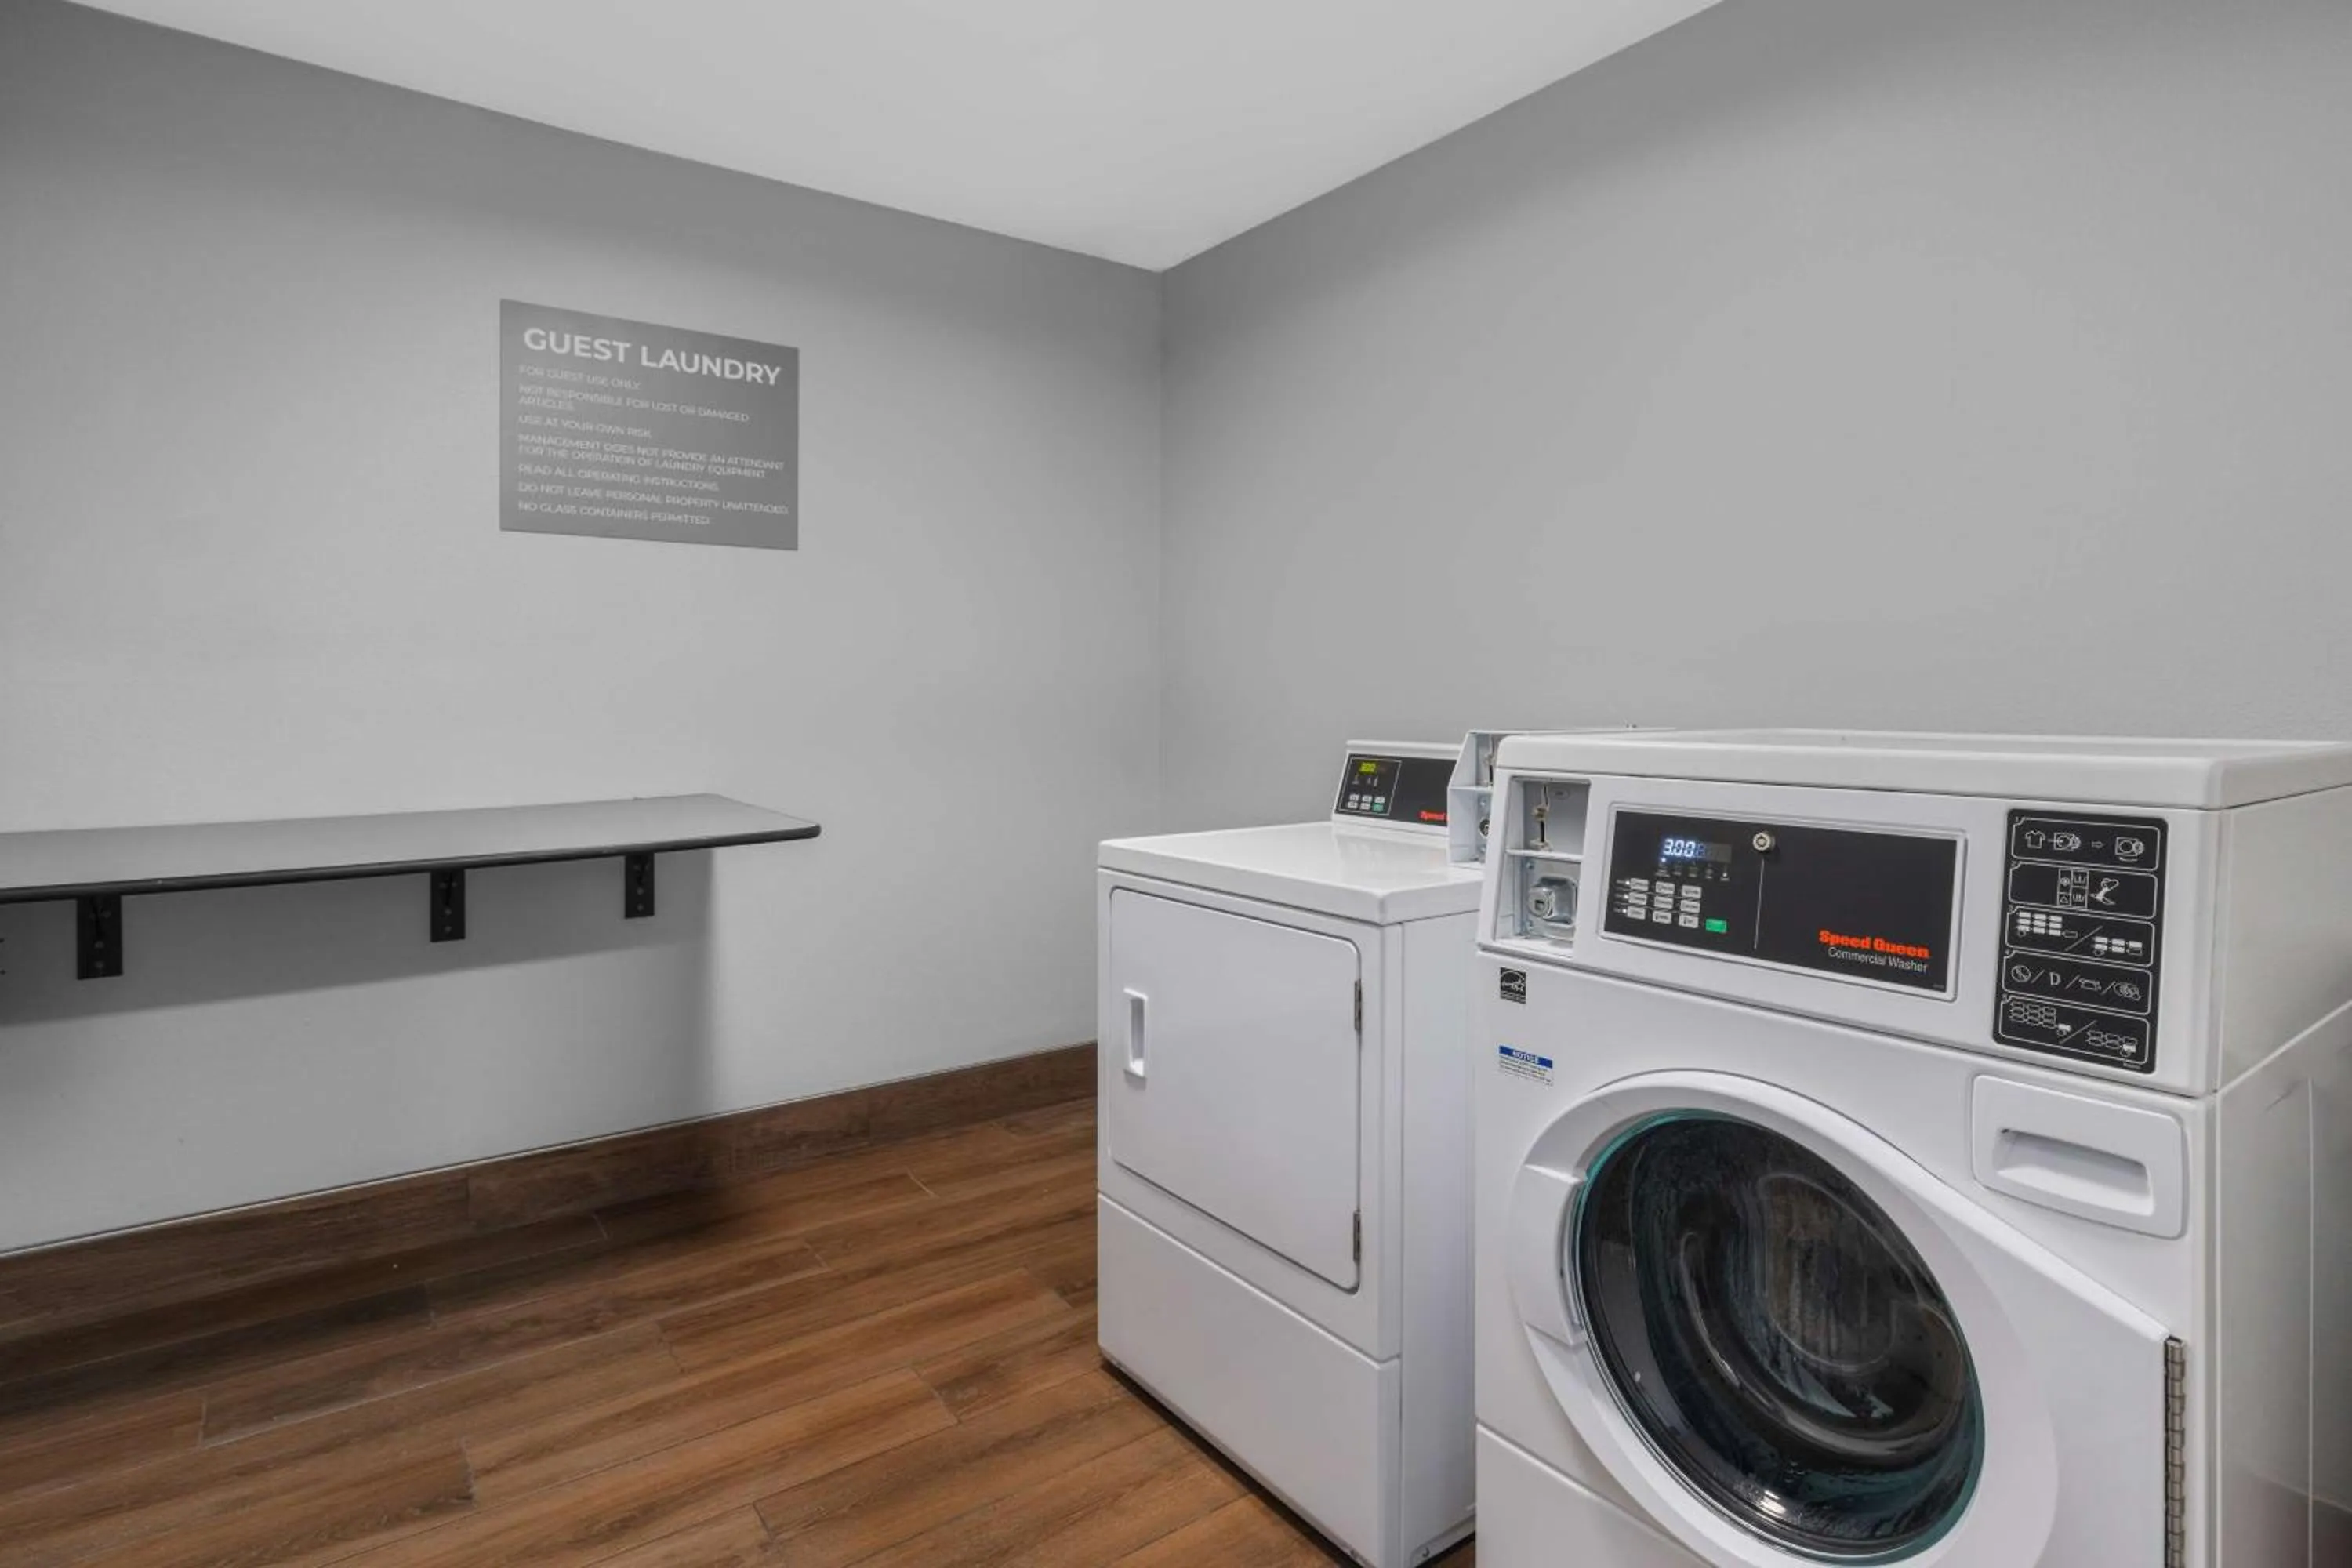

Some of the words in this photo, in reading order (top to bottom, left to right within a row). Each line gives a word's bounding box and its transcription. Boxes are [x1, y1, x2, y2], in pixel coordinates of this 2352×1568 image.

[523, 328, 631, 363] GUEST
[640, 345, 781, 386] LAUNDRY
[518, 364, 544, 376] FOR
[547, 368, 583, 381] GUEST
[587, 375, 608, 387] USE
[518, 383, 543, 394] NOT
[546, 387, 622, 405] RESPONSIBLE
[626, 397, 650, 408] FOR
[652, 401, 677, 412] LOST
[679, 405, 695, 415] OR
[698, 406, 750, 422] DAMAGED
[518, 415, 542, 426] USE
[546, 418, 558, 426] AT
[561, 419, 593, 431] YOUR
[595, 423, 625, 435] OWN
[518, 434, 600, 449] MANAGEMENT
[604, 443, 635, 454] DOES
[637, 446, 659, 457] NOT
[662, 449, 706, 462] PROVIDE
[710, 453, 725, 464] AN
[727, 457, 784, 470] ATTENDANT
[518, 445, 544, 456] FOR
[547, 448, 569, 459] THE
[572, 450, 635, 465] OPERATION
[637, 456, 653, 466] OF
[655, 459, 705, 472] LAUNDRY
[518, 463, 552, 475] READ
[554, 466, 575, 477] ALL
[577, 470, 640, 484] OPERATING
[518, 481, 538, 492] DO
[540, 484, 565, 494] NOT
[568, 486, 602, 499] LEAVE
[605, 489, 662, 504] PERSONAL
[666, 495, 720, 508] PROPERTY
[518, 500, 538, 511] NO
[539, 503, 577, 515] GLASS
[579, 506, 648, 521] CONTAINERS
[1818, 929, 1871, 949] Speed
[1873, 937, 1929, 959] Queen
[1828, 946, 1886, 966] Commercial
[1888, 956, 1929, 974] Washer
